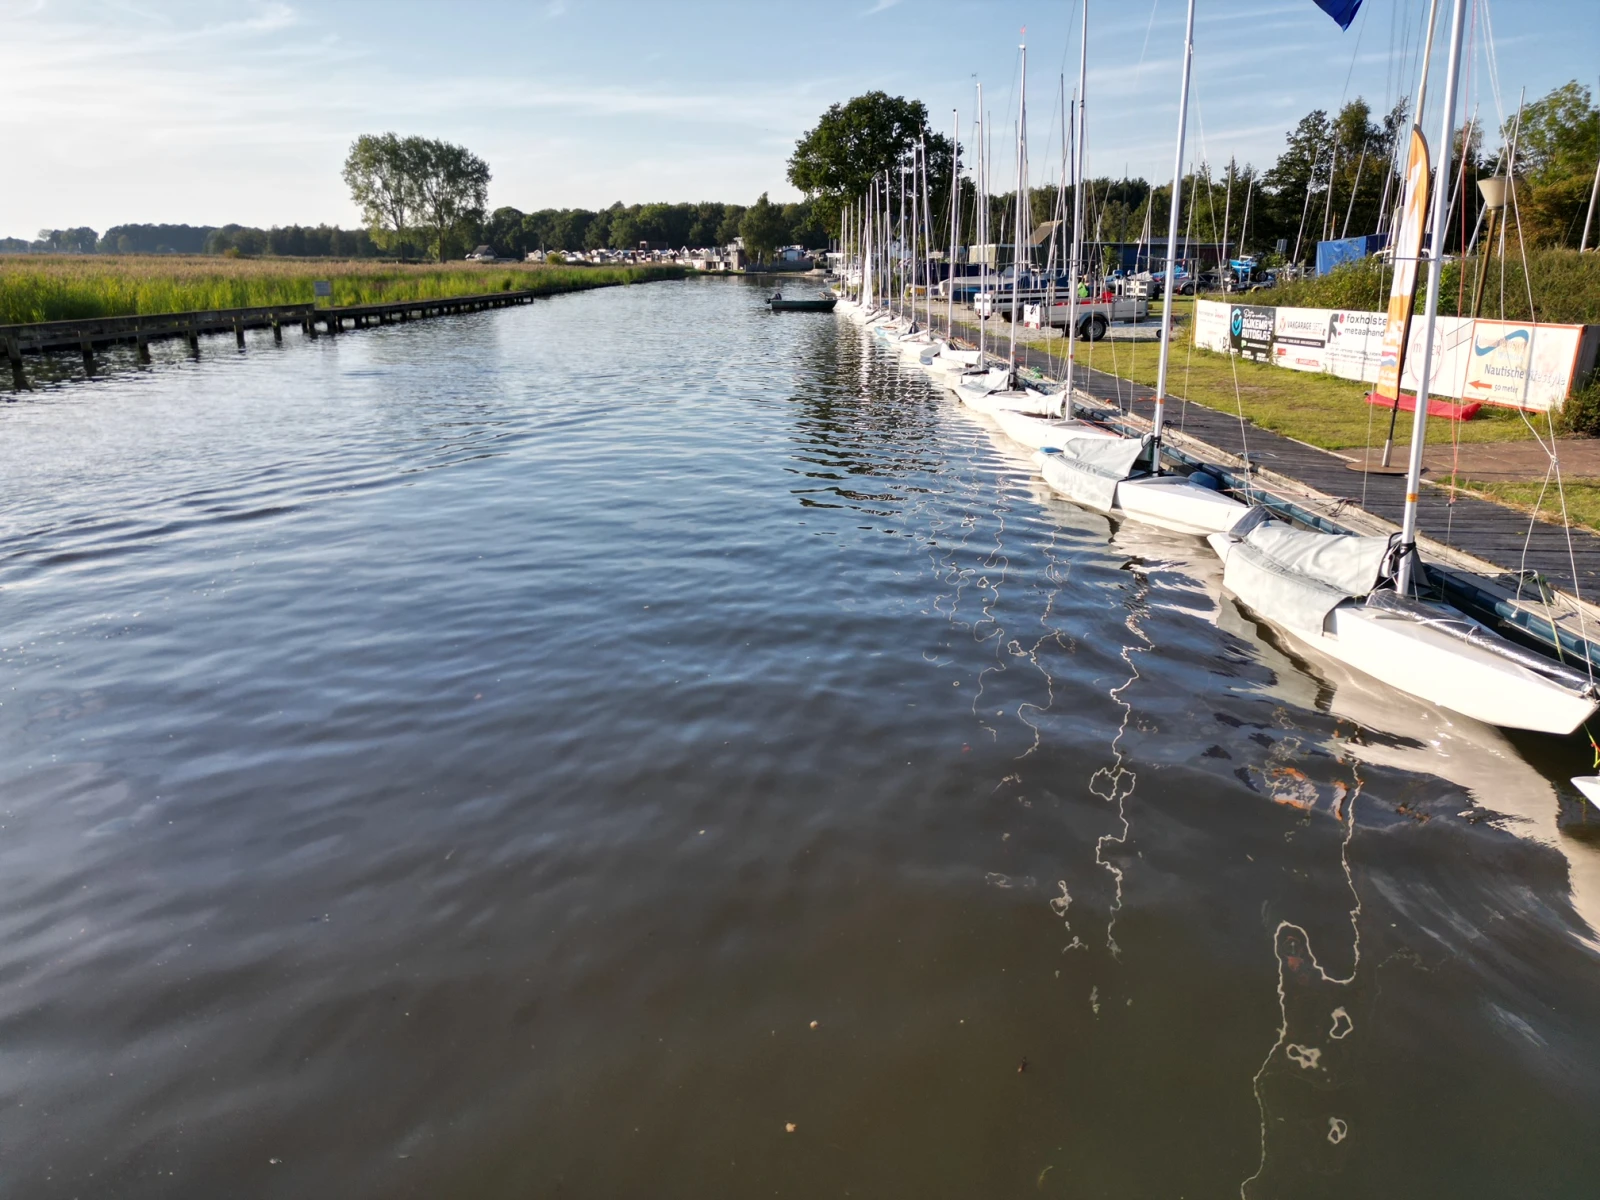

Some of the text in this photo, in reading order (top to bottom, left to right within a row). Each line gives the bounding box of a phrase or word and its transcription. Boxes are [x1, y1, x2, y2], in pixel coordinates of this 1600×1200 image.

[1346, 313, 1387, 326] foxholste
[1241, 328, 1271, 341] AUTOGLAS
[1344, 327, 1385, 337] metaalhand
[1484, 363, 1525, 379] Nautische
[1494, 384, 1519, 394] 50 meter
